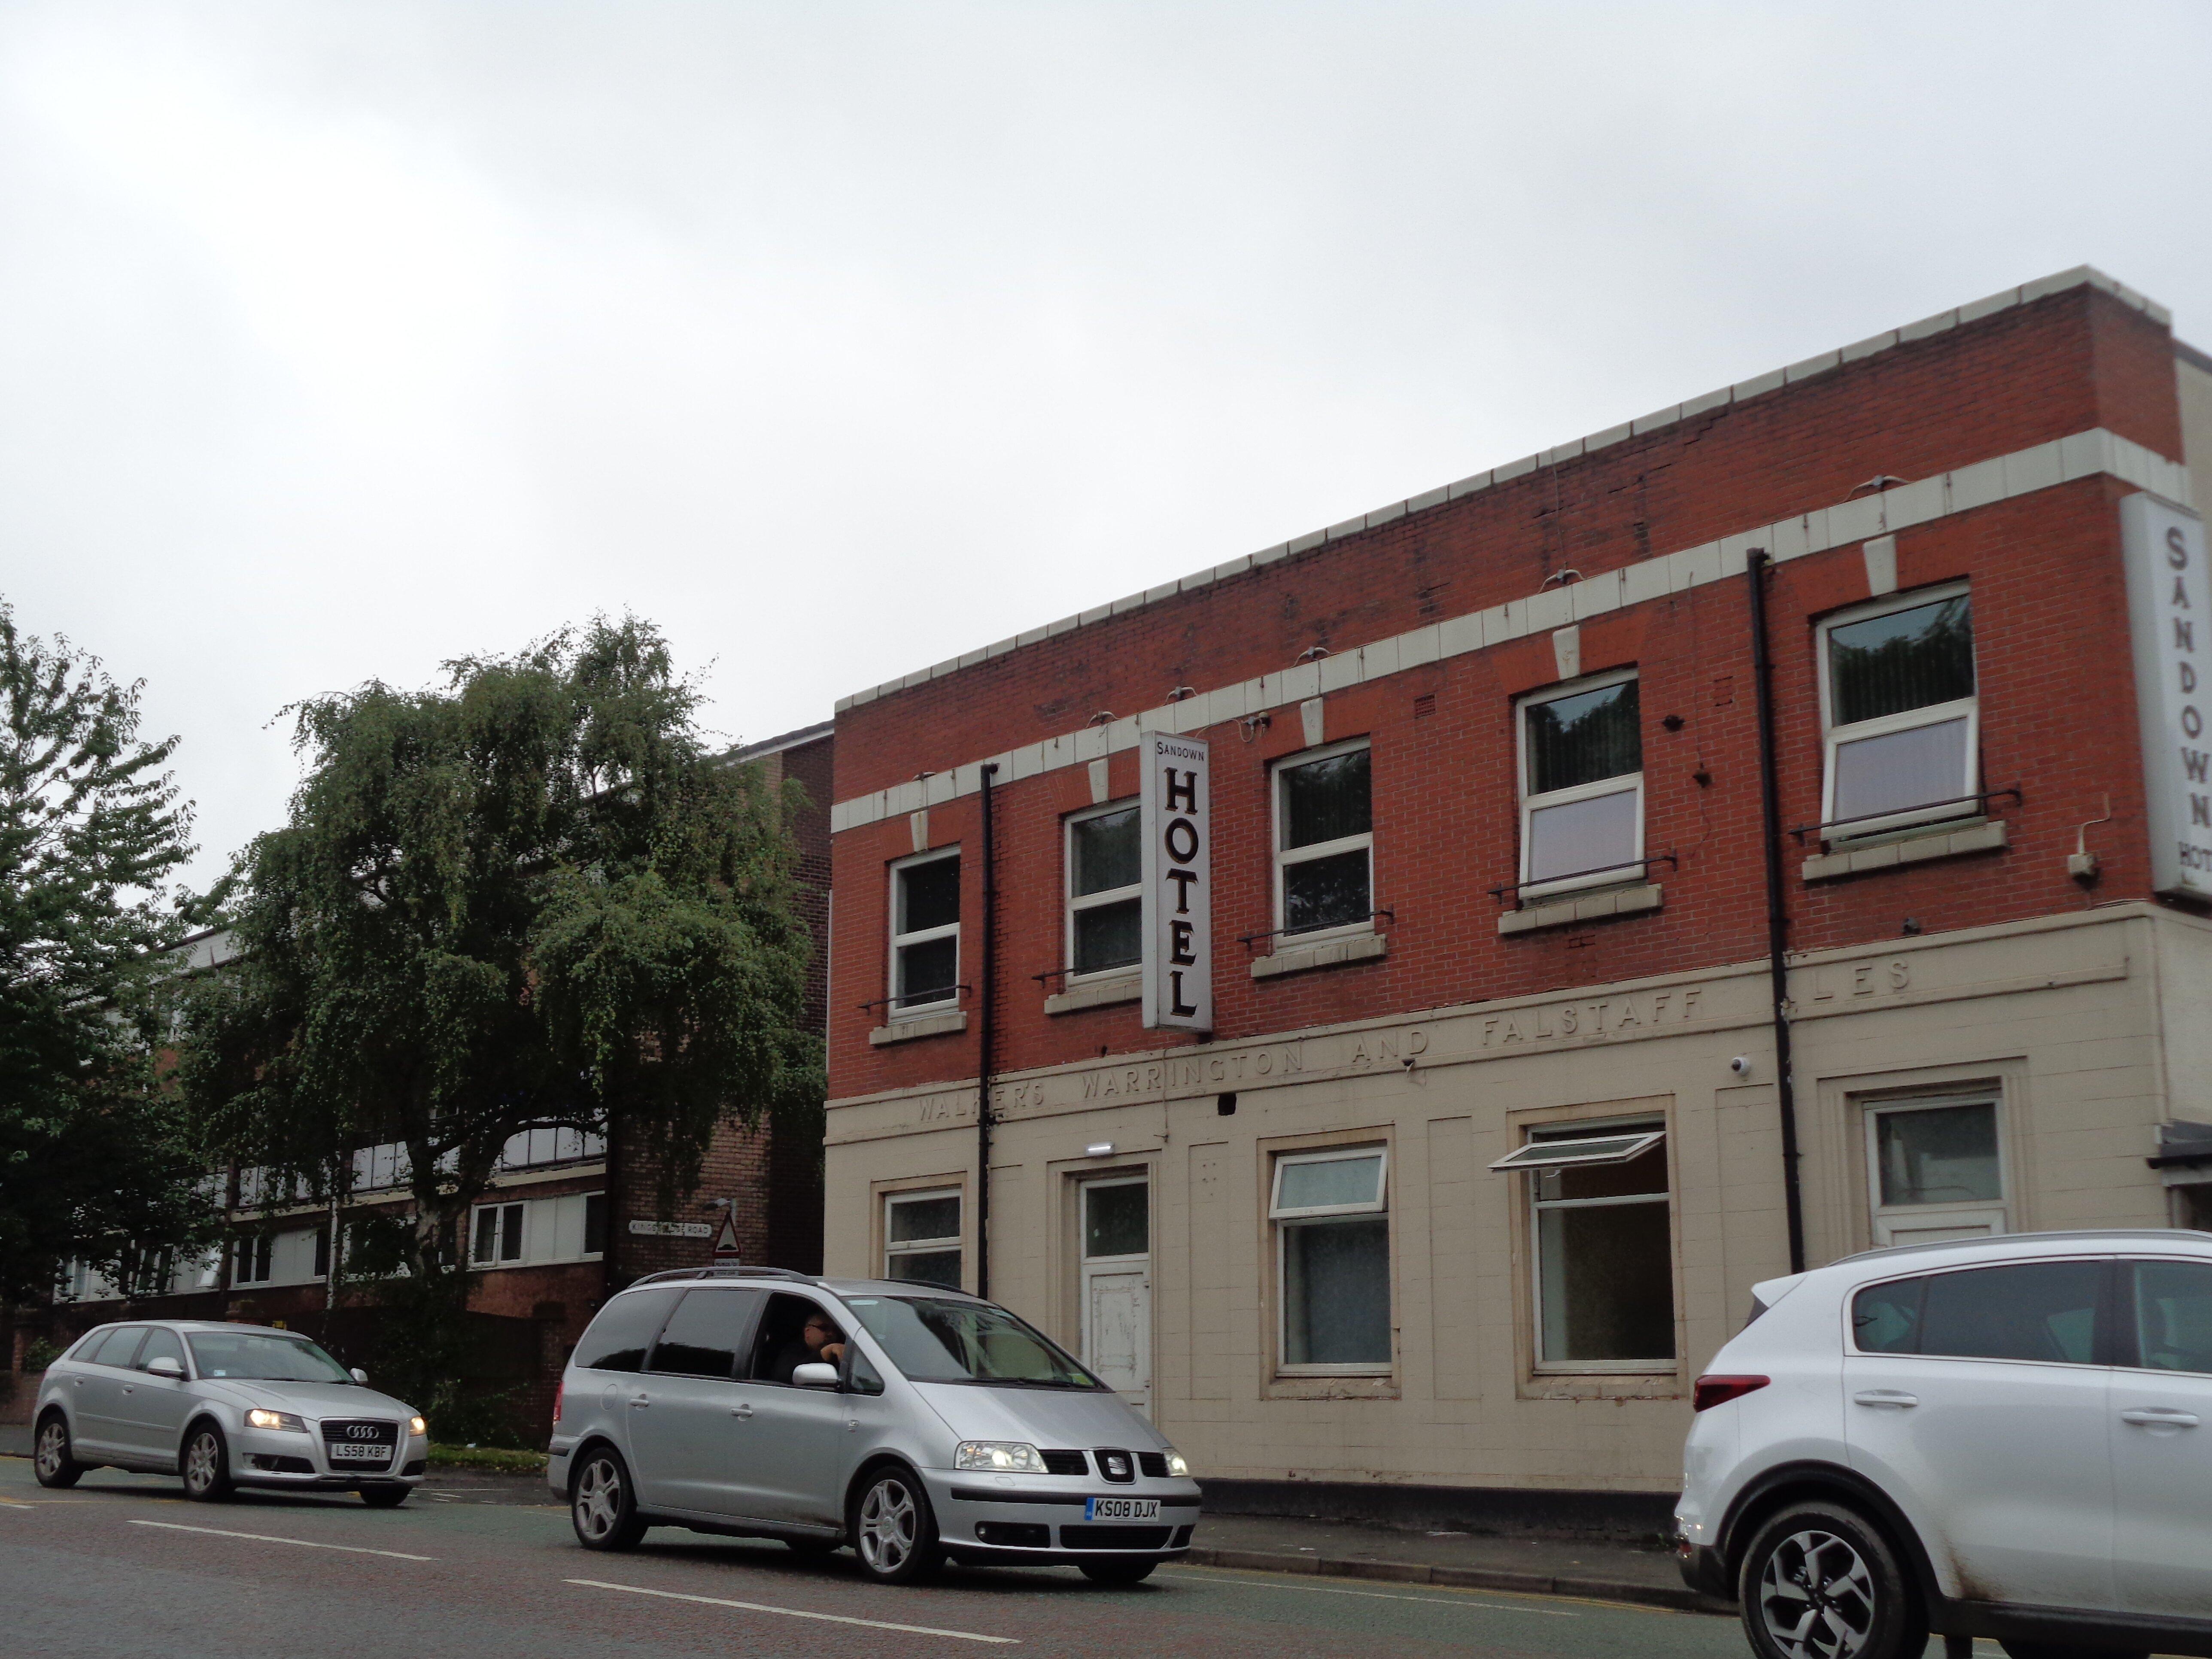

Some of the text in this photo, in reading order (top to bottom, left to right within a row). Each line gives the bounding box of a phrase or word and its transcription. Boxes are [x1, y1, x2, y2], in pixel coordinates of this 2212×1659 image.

[2164, 526, 2211, 829] SANDOWN
[1157, 741, 1204, 762] SANDOWN
[1164, 766, 1200, 1018] HOTEL
[1082, 1044, 1304, 1098] WARRINGTON
[1352, 1031, 1430, 1063] AND
[1481, 988, 1702, 1045] FALSTAFF
[1787, 958, 1911, 1004] LES
[336, 1445, 387, 1458] LS58 KBF
[1095, 1500, 1157, 1518] KS08 DJX
